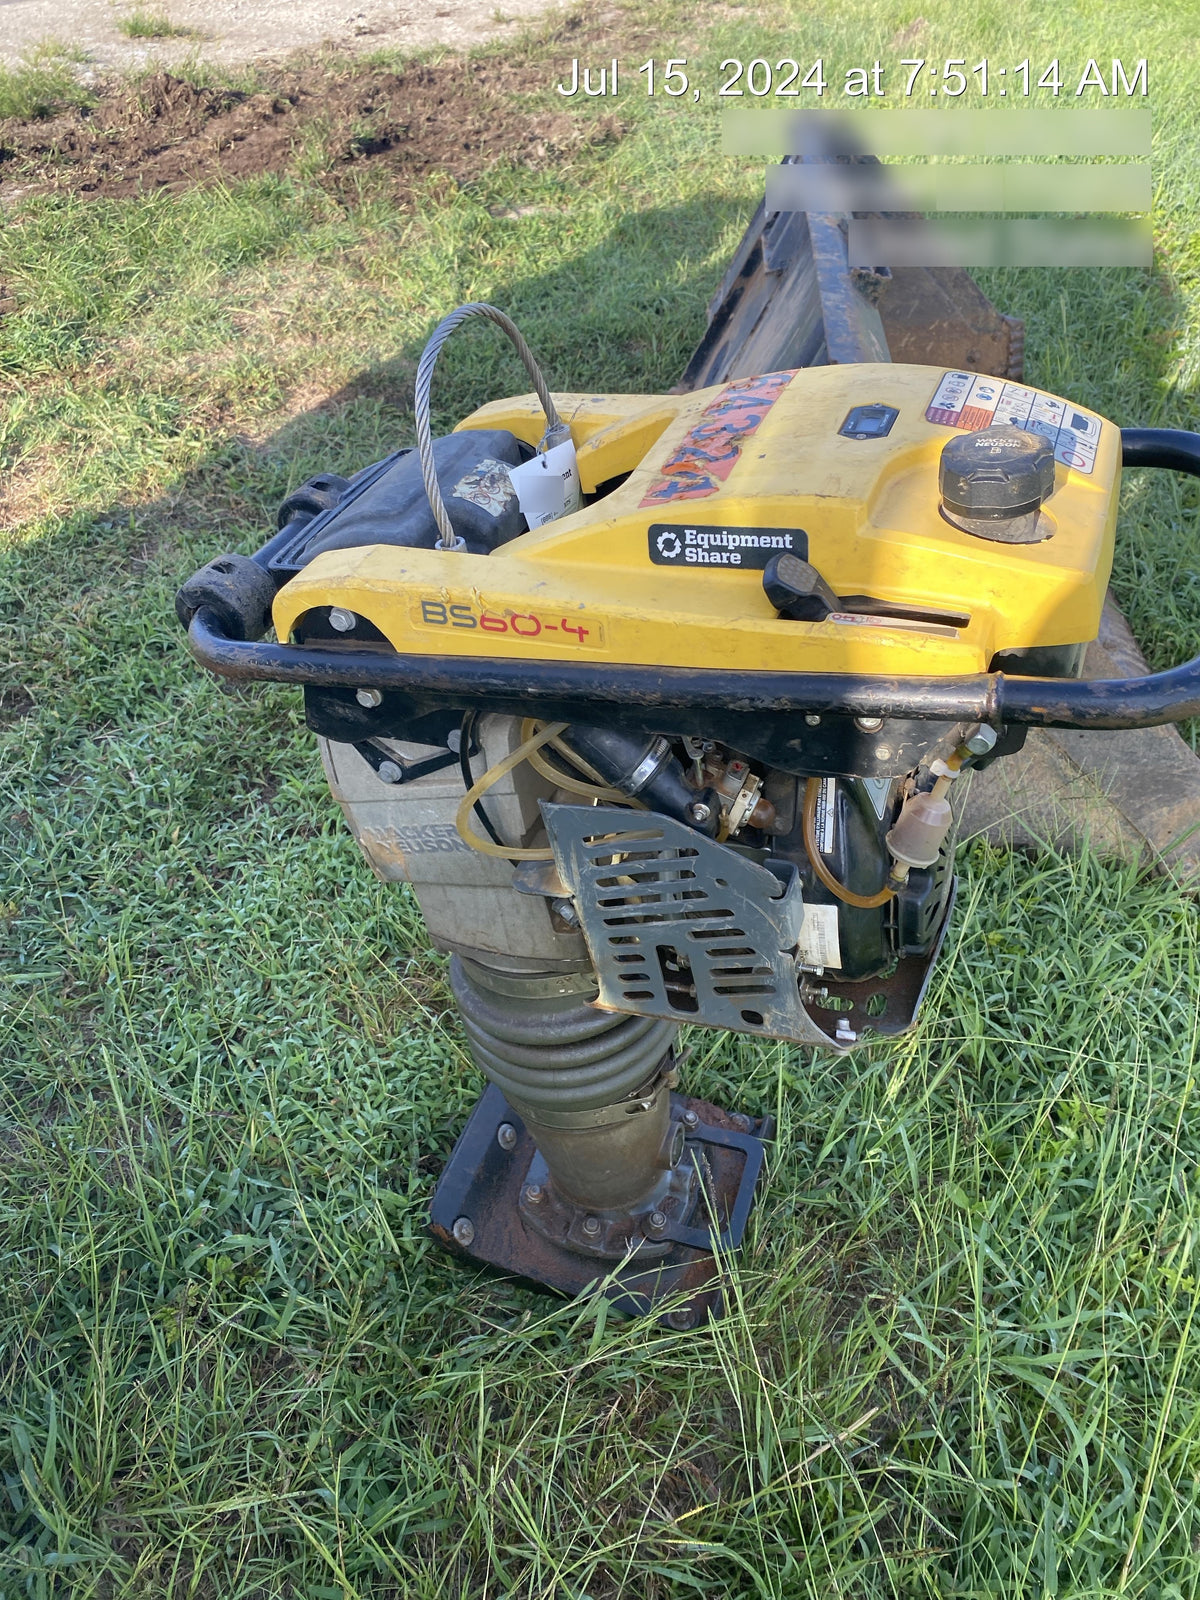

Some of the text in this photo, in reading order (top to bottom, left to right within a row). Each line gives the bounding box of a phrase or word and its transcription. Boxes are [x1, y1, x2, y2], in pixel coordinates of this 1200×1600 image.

[684, 529, 793, 550] Equipment
[685, 547, 742, 565] Share
[421, 600, 590, 643] BS60-4
